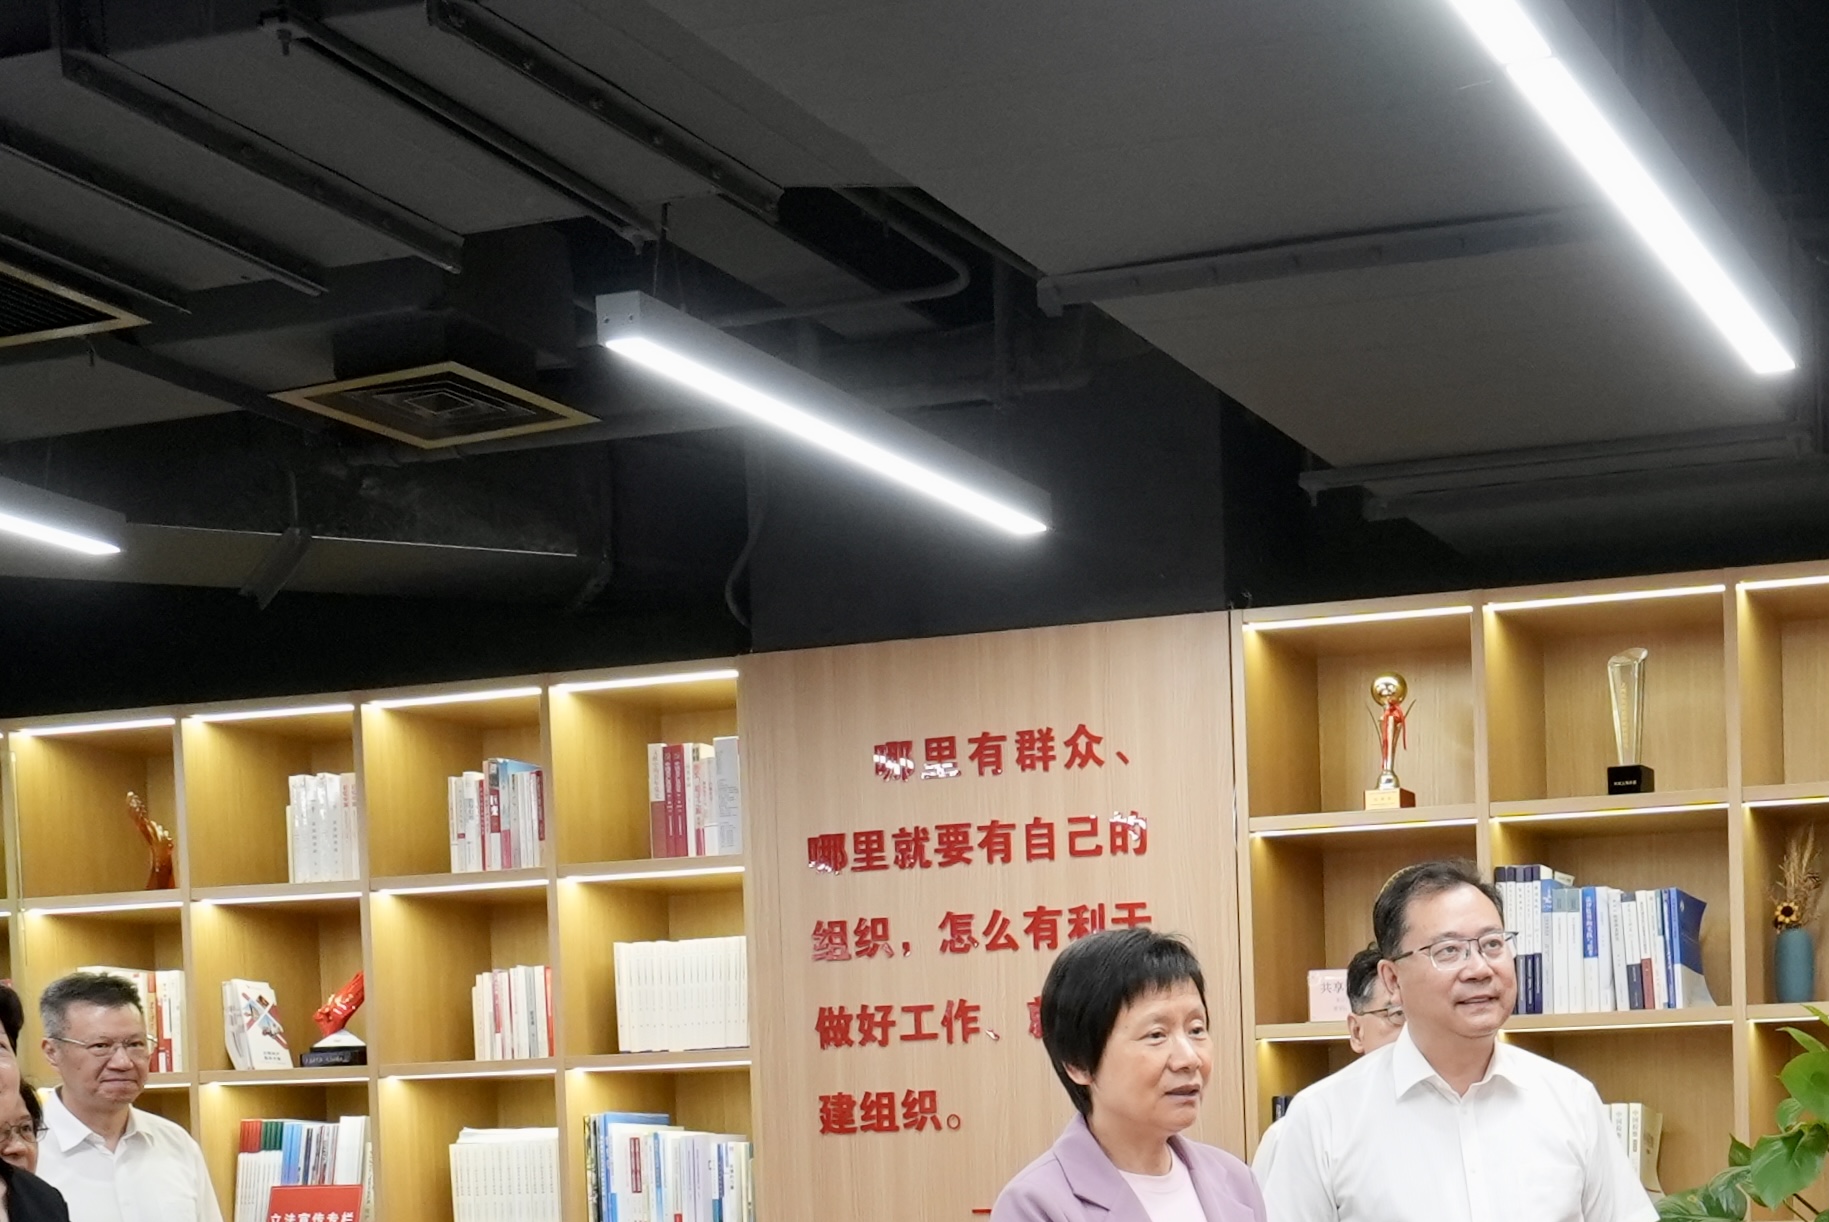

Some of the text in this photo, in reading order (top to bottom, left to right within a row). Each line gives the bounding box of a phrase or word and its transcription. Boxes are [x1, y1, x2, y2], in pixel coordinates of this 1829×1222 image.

[873, 723, 1131, 781] 哪里有群众、
[807, 810, 1148, 876] 哪里就要有自己的
[818, 1088, 961, 1136] 建组织。
